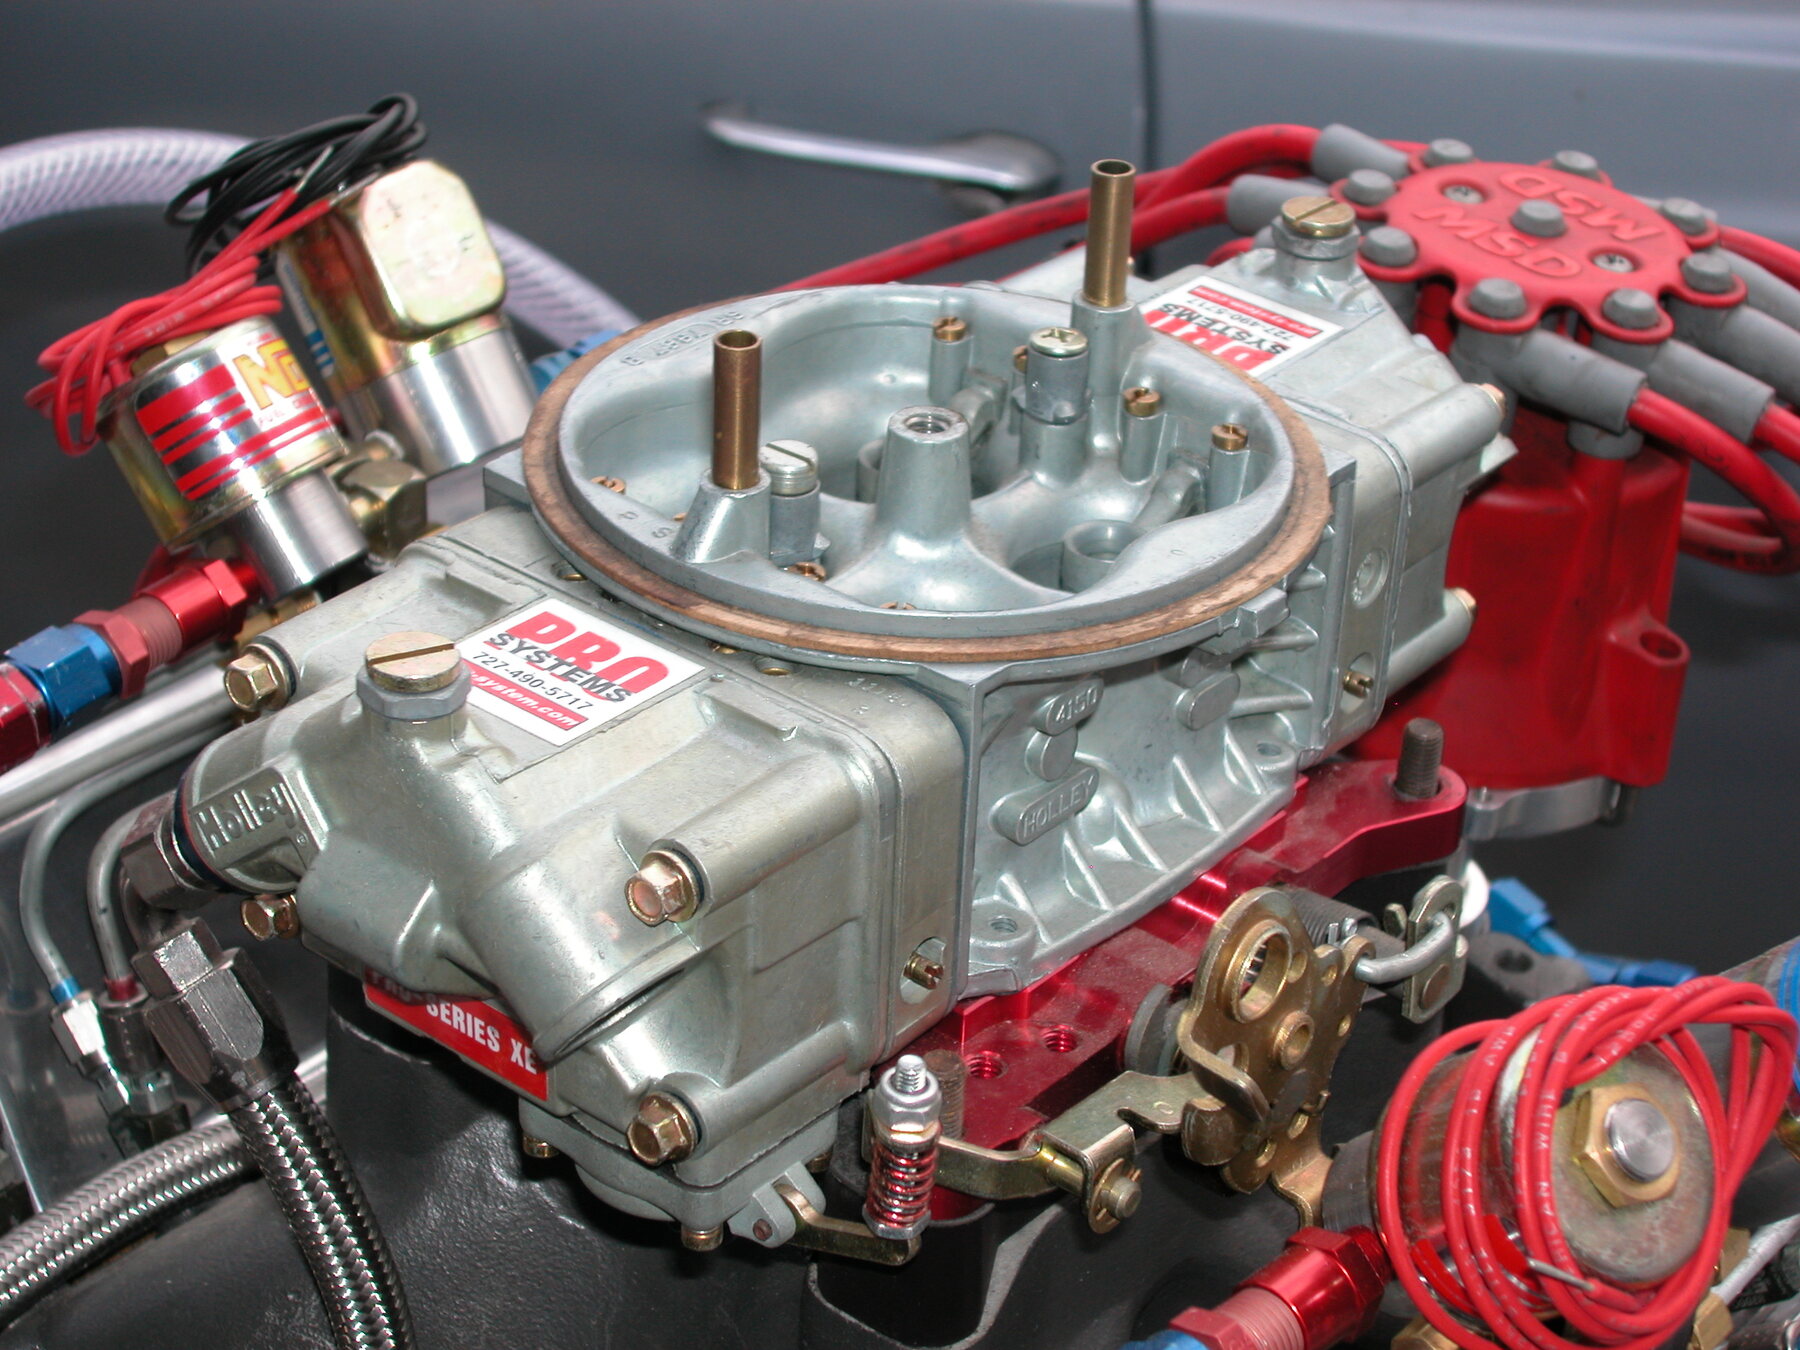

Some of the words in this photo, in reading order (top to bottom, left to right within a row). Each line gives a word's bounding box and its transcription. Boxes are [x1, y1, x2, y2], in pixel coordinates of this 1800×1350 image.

[1499, 171, 1666, 241] MSD
[1411, 206, 1582, 278] MSD
[1158, 303, 1290, 355] SYSTEMS
[472, 651, 594, 710] 727-490-5717
[486, 610, 669, 701] PRO
[489, 632, 634, 704] SYSTEMS
[471, 671, 580, 728] -system.com
[1055, 685, 1097, 724] 4150
[195, 782, 298, 859] Holley
[1023, 773, 1094, 839] HOLLEY
[425, 994, 501, 1054] SERIES
